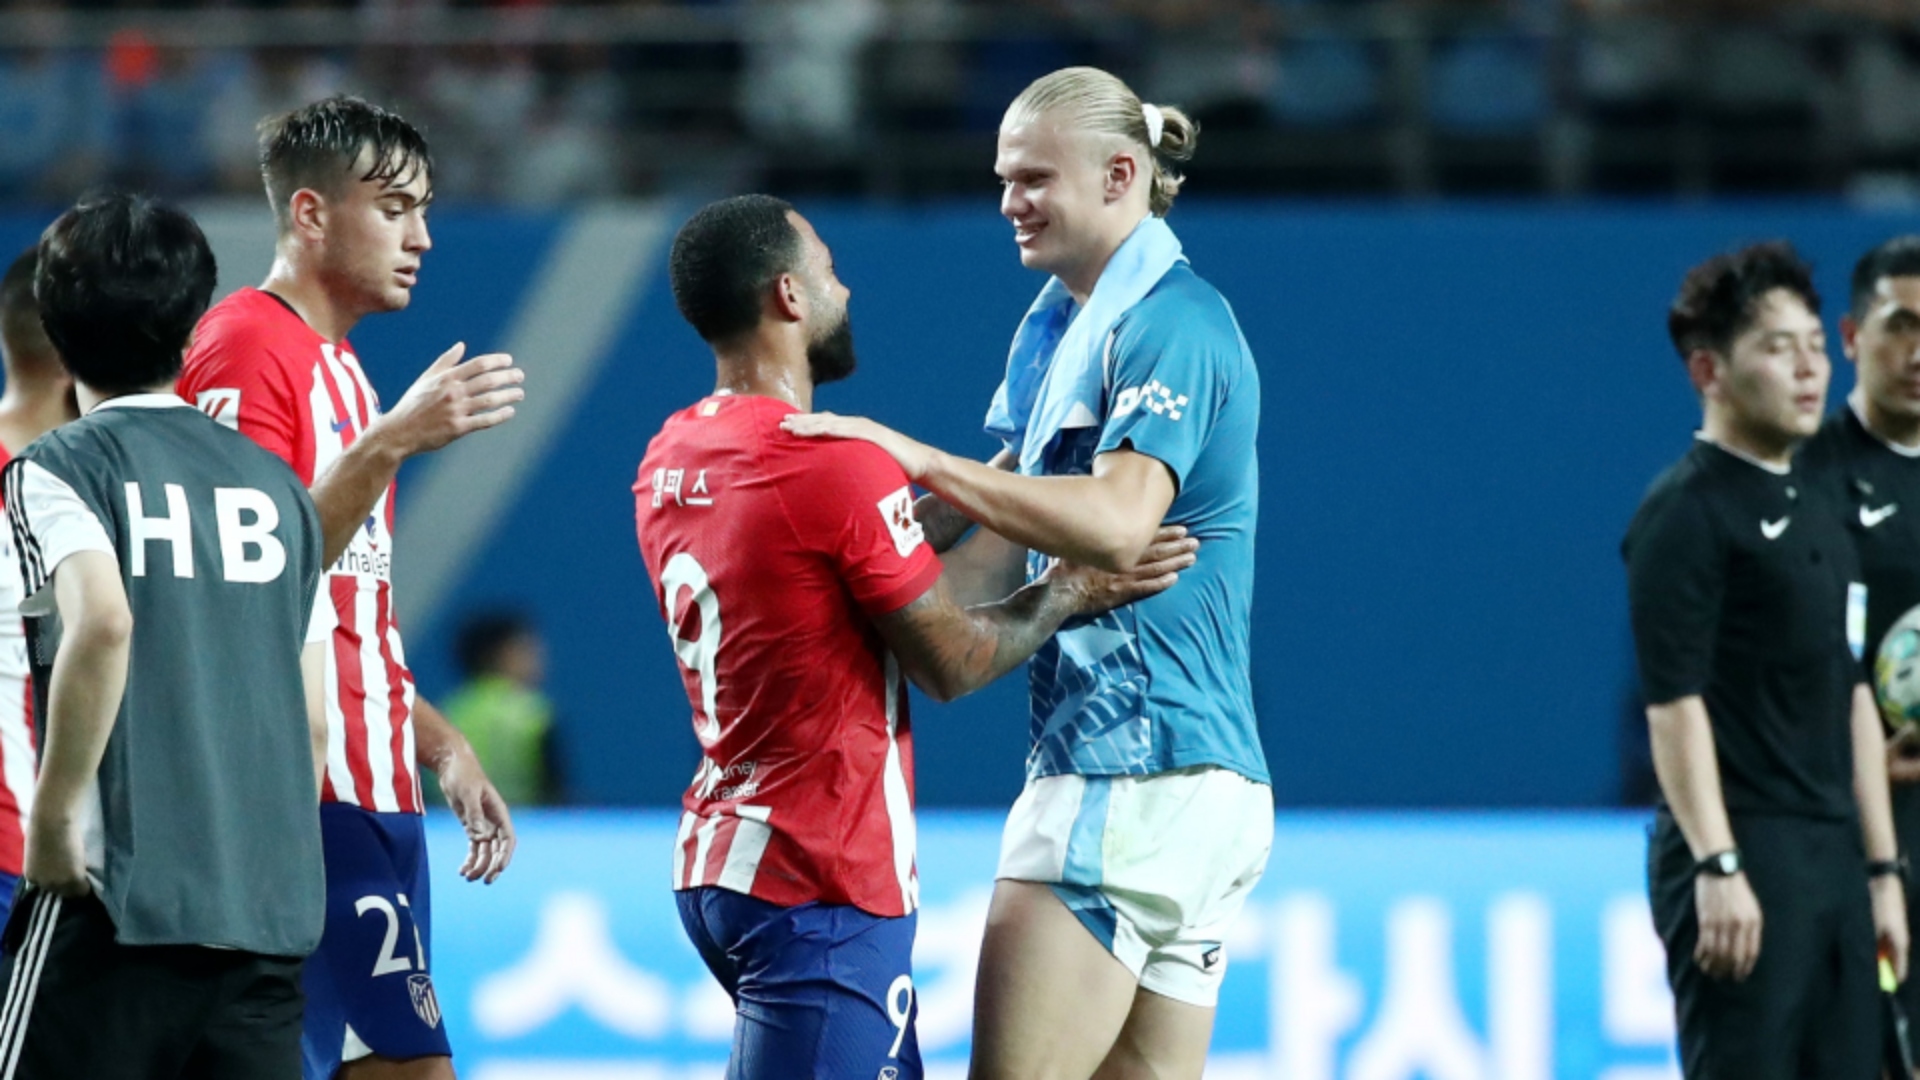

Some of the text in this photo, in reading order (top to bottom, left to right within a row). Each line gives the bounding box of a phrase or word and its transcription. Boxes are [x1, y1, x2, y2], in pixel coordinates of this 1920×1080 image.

[124, 481, 287, 584] HB
[660, 552, 722, 744] 9
[887, 973, 914, 1059] 9
